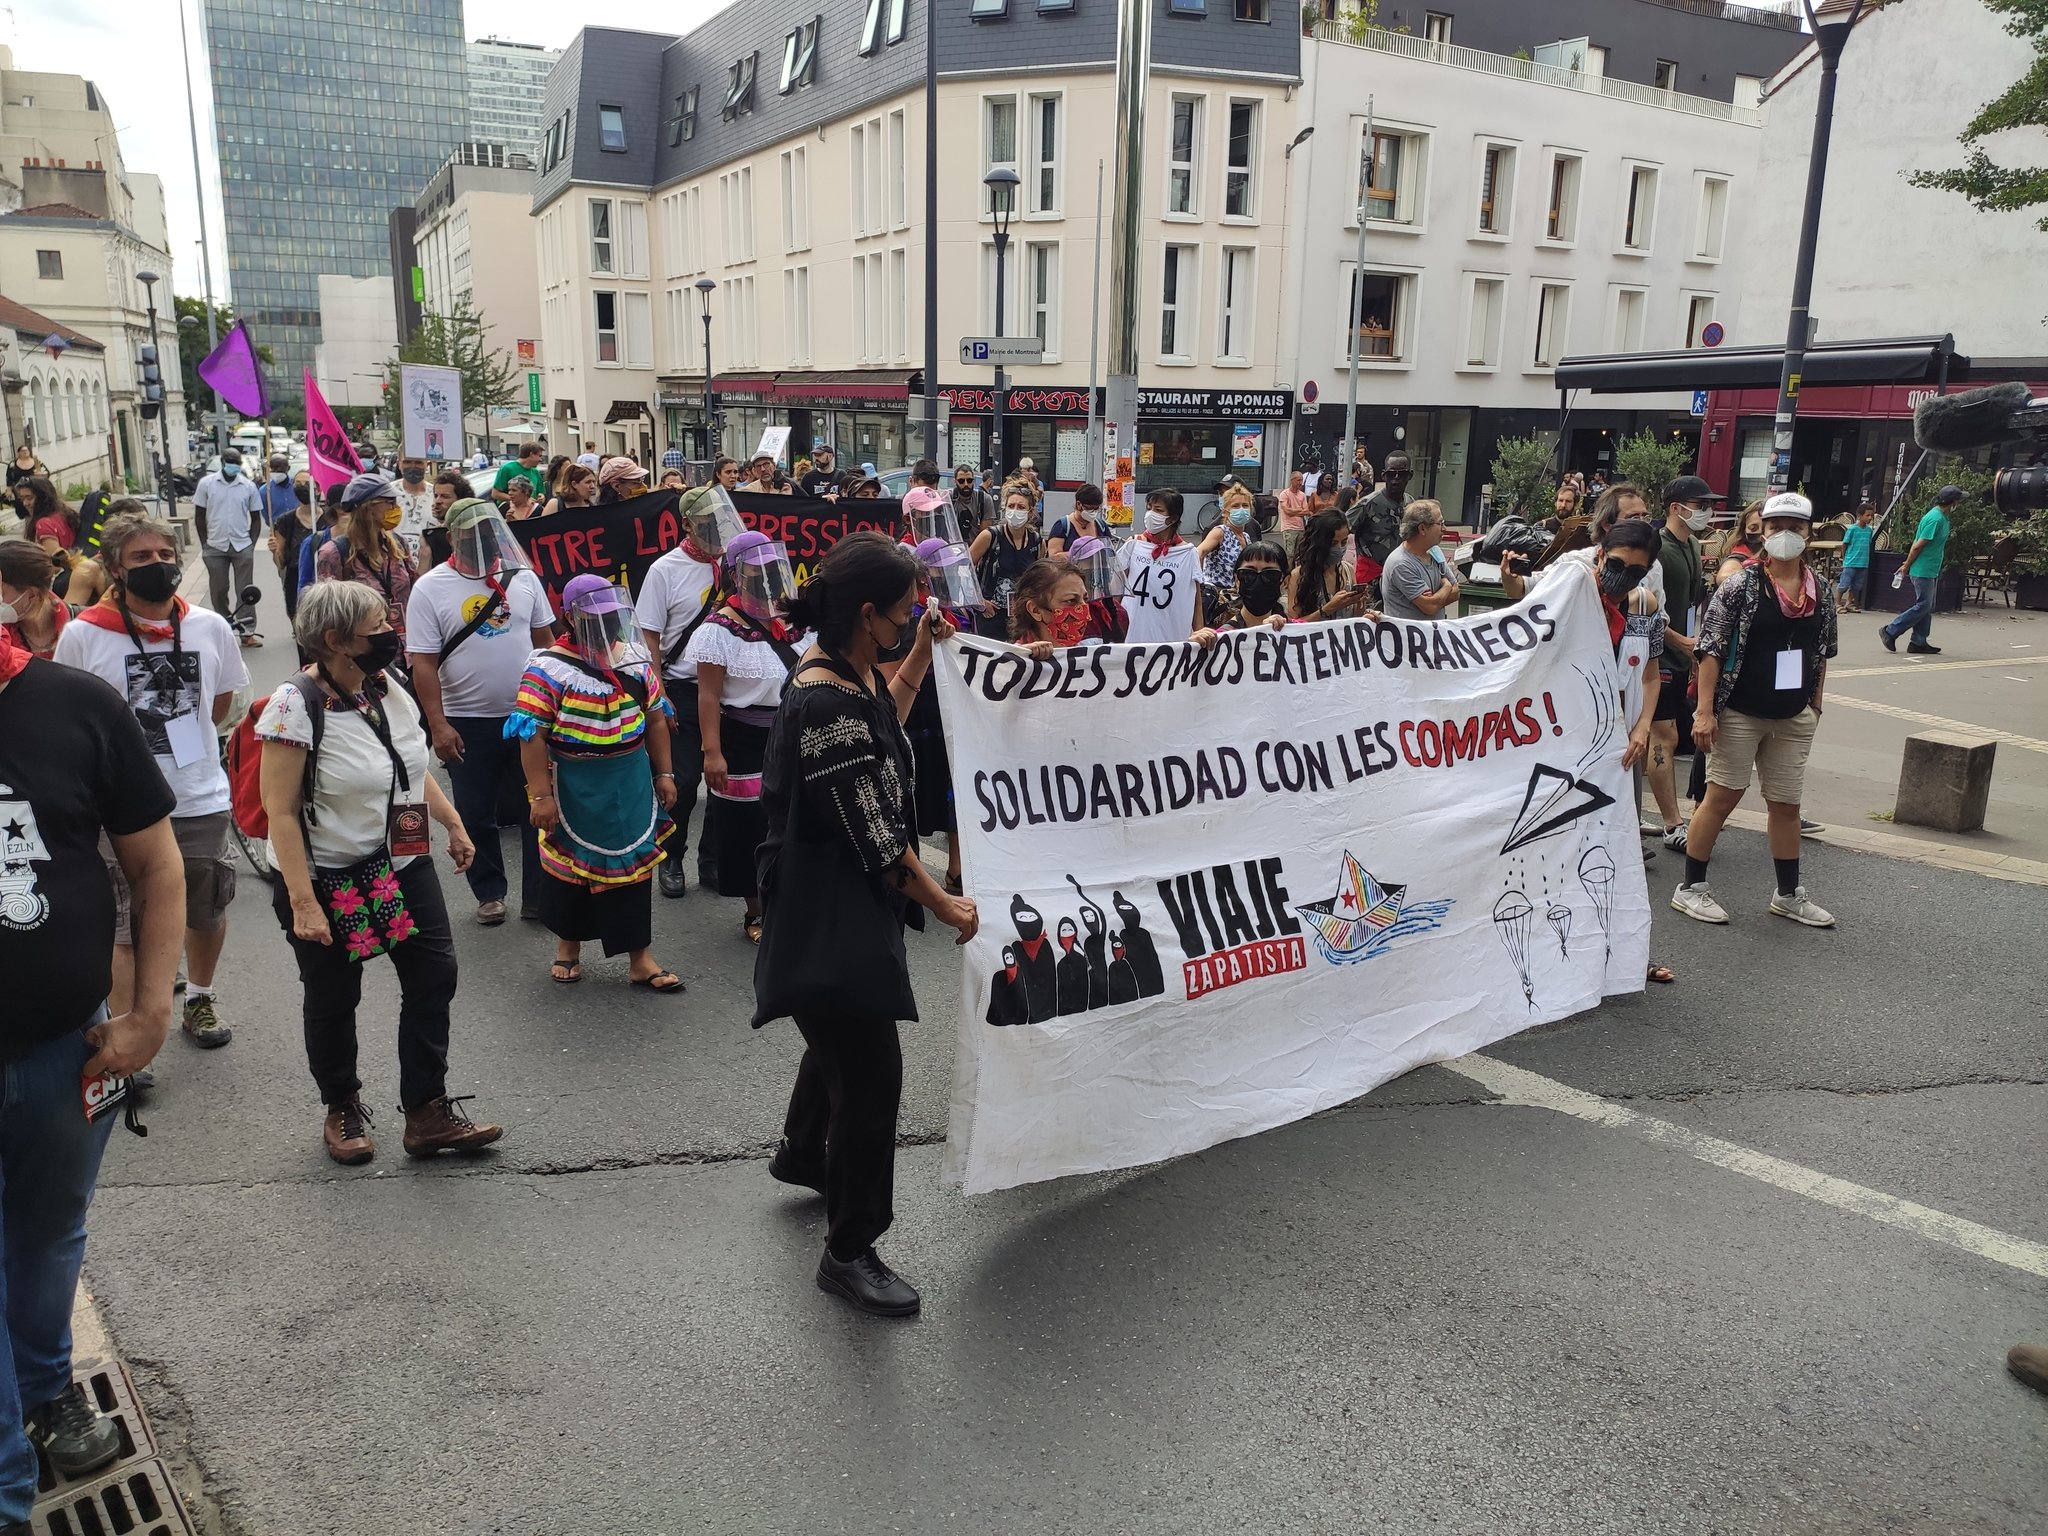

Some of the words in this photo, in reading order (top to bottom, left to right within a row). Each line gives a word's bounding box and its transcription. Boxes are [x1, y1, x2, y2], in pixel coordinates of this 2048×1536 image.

[1009, 390, 1097, 411] KYOTO
[1138, 392, 1211, 405] STAURANT
[1217, 394, 1284, 407] JAPONAIS
[527, 528, 612, 577] NTRE
[633, 510, 678, 556] LA
[1136, 556, 1151, 565] NOS
[1152, 560, 1180, 569] FALTAN
[1132, 566, 1176, 610] 43
[959, 645, 1111, 701] TODES
[1113, 632, 1247, 698] SOMOS
[974, 747, 1247, 833] SOLIDARIDAD
[1256, 741, 1335, 793] CON
[1336, 721, 1398, 783] LES
[6, 842, 35, 855] EZLN
[1156, 856, 1302, 959] VIAJE
[1314, 903, 1330, 913] 2021
[1186, 940, 1303, 993] ZAPATISTA
